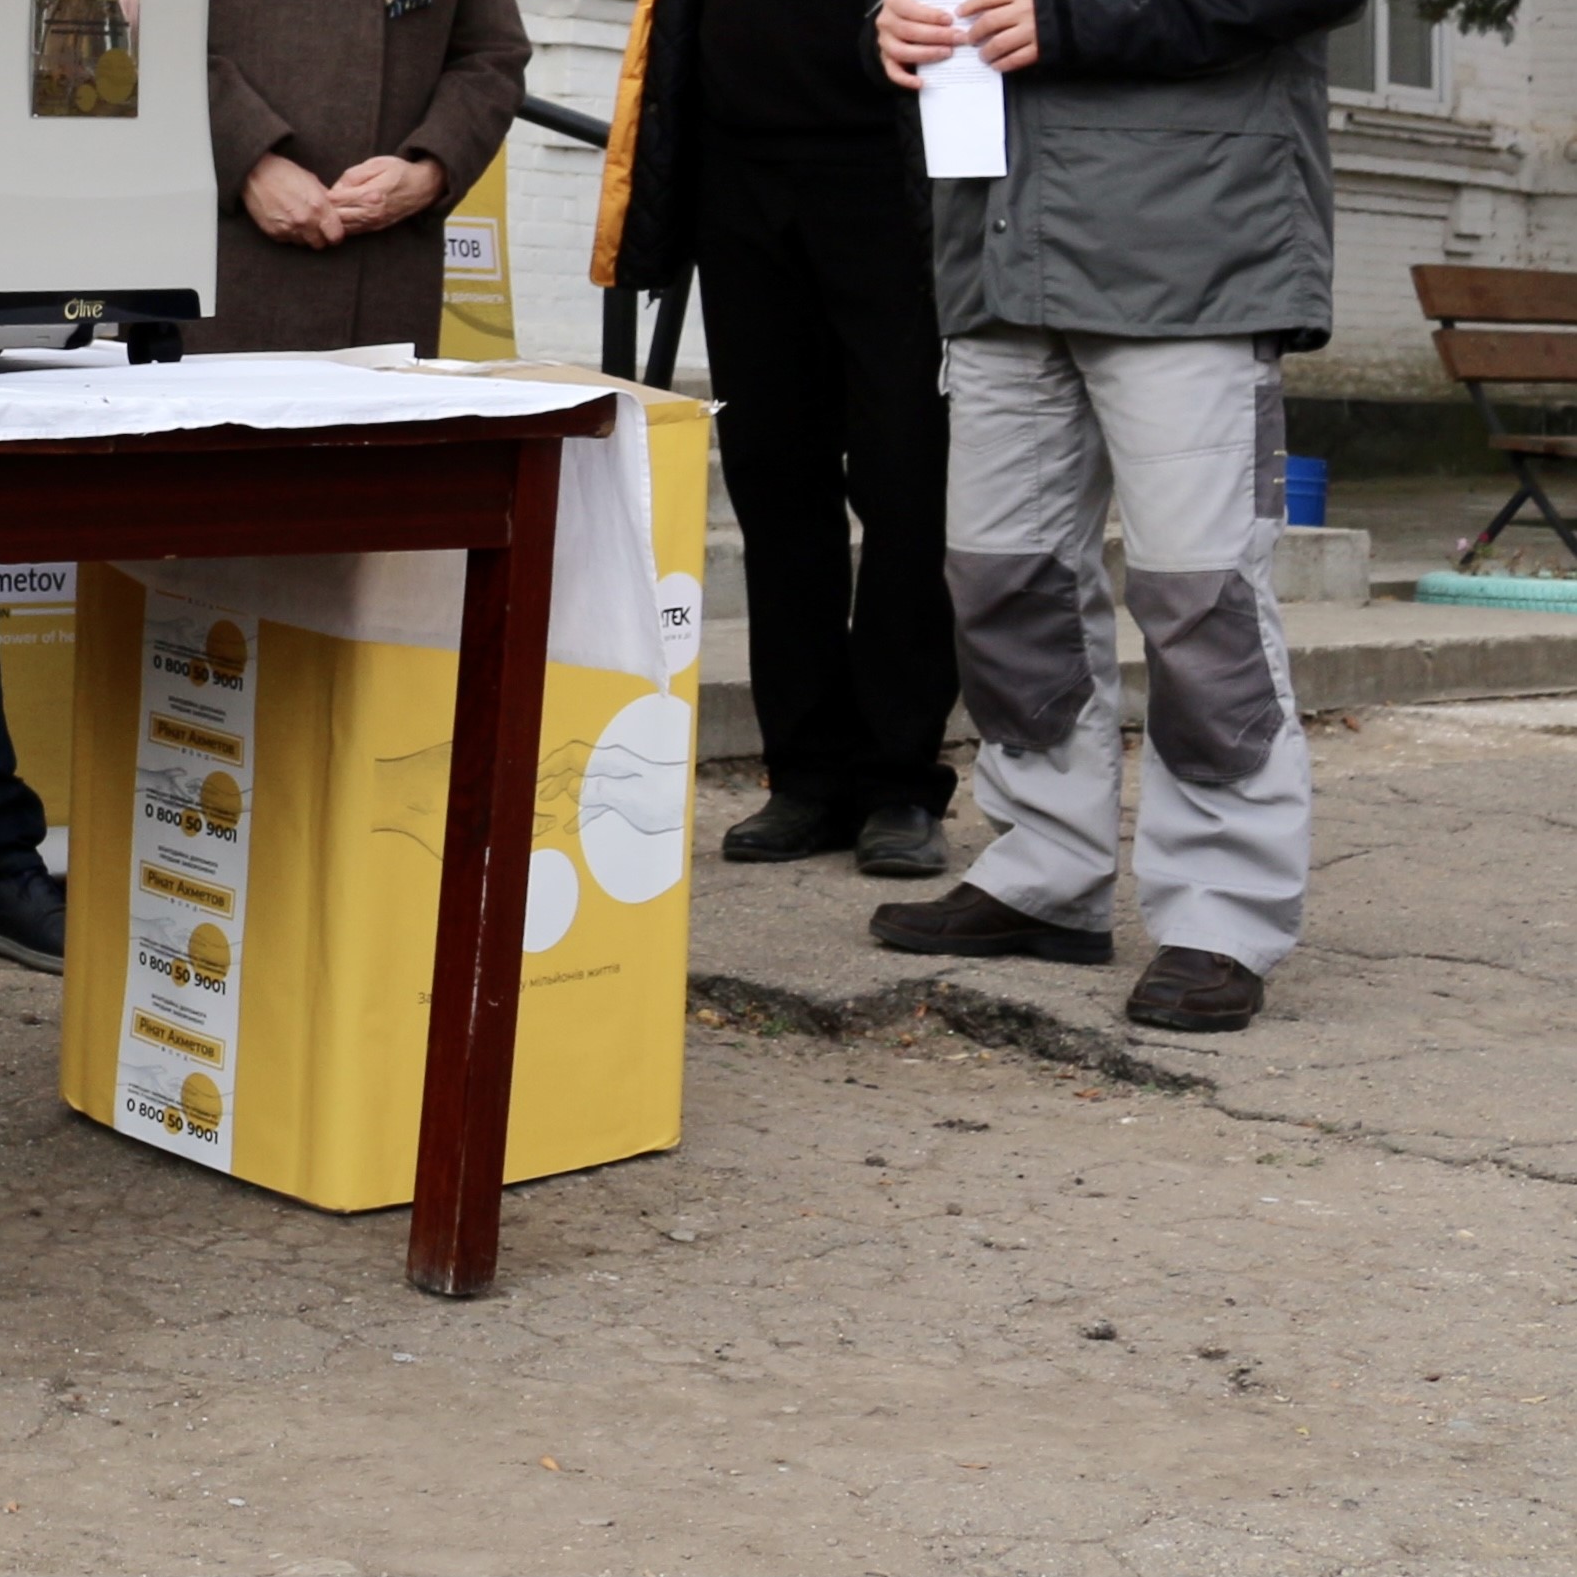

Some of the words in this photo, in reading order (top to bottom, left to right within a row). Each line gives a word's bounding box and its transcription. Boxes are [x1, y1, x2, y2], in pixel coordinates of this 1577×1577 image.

[64, 298, 103, 320] Olive
[153, 655, 162, 669] 0
[165, 657, 191, 678] 800
[193, 665, 209, 682] 50
[212, 673, 243, 692] 9001
[145, 803, 153, 818] 0
[156, 807, 182, 826] 800
[185, 815, 202, 833] 50
[206, 822, 237, 843] 9001
[139, 951, 146, 965] 0
[149, 956, 172, 976] 800
[174, 966, 191, 983] 50
[194, 973, 226, 995] 9001
[530, 969, 584, 987] мільйонів
[127, 1098, 136, 1113] 0
[139, 1102, 164, 1123] 800
[168, 1113, 183, 1131] 50
[187, 1121, 218, 1144] 9001
